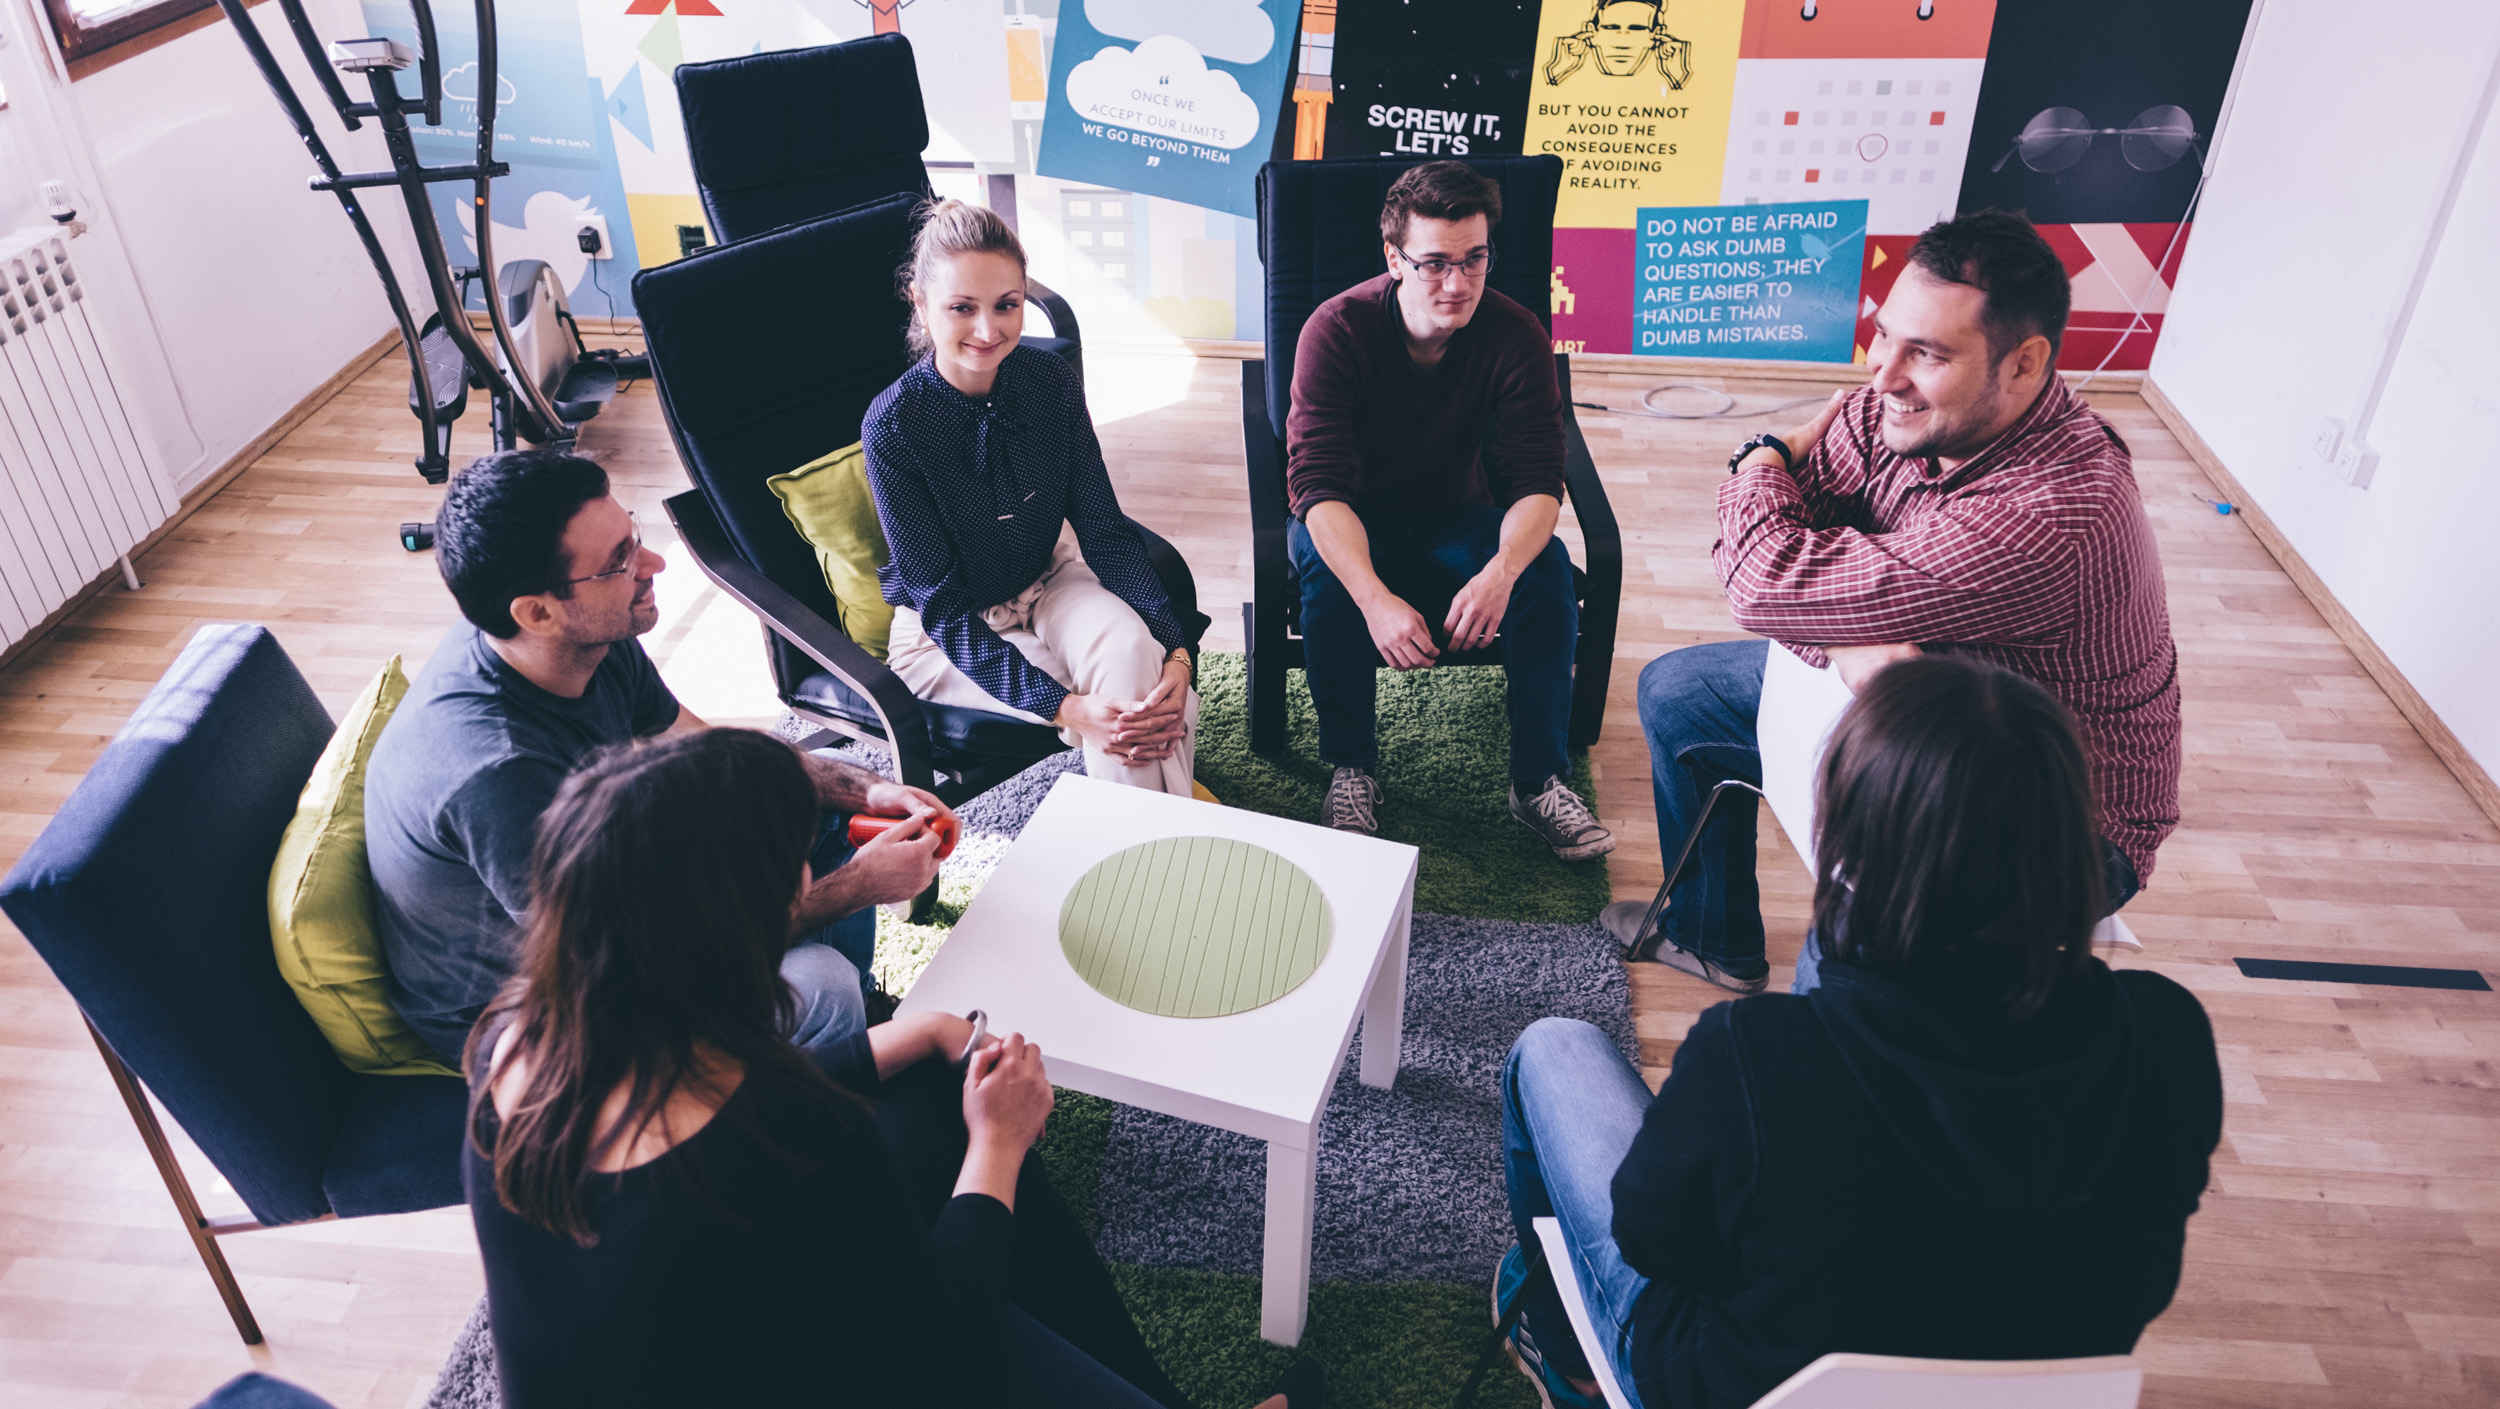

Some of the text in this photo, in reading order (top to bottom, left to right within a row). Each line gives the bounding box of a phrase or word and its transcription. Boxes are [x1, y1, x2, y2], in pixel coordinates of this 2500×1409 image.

[1131, 88, 1196, 112] ONCE WE
[1089, 103, 1229, 142] ACCEPT OUR LIMITS.
[1367, 104, 1501, 141] SCREW IT,
[1538, 104, 1689, 119] BUT YOU CANNOT
[1567, 123, 1656, 136] AVOID THE
[1082, 121, 1231, 164] WE GO BEYOND THEM
[1395, 130, 1469, 155] LET'S
[1541, 140, 1677, 155] CONSEQUENCES
[1581, 160, 1662, 173] AVOIDING
[1569, 177, 1641, 190] REALITY.
[1647, 211, 1838, 237] DO NOT BE AFRAID
[1645, 237, 1786, 259] TO ASK DUMB
[1644, 258, 1827, 282] QUESTIONS; THEY
[1643, 281, 1793, 303] ARE EASIER TO
[1643, 304, 1781, 325] HANDLE THAN
[1552, 340, 1586, 354] ART
[1642, 325, 1808, 347] DUMB MISTAKES.
